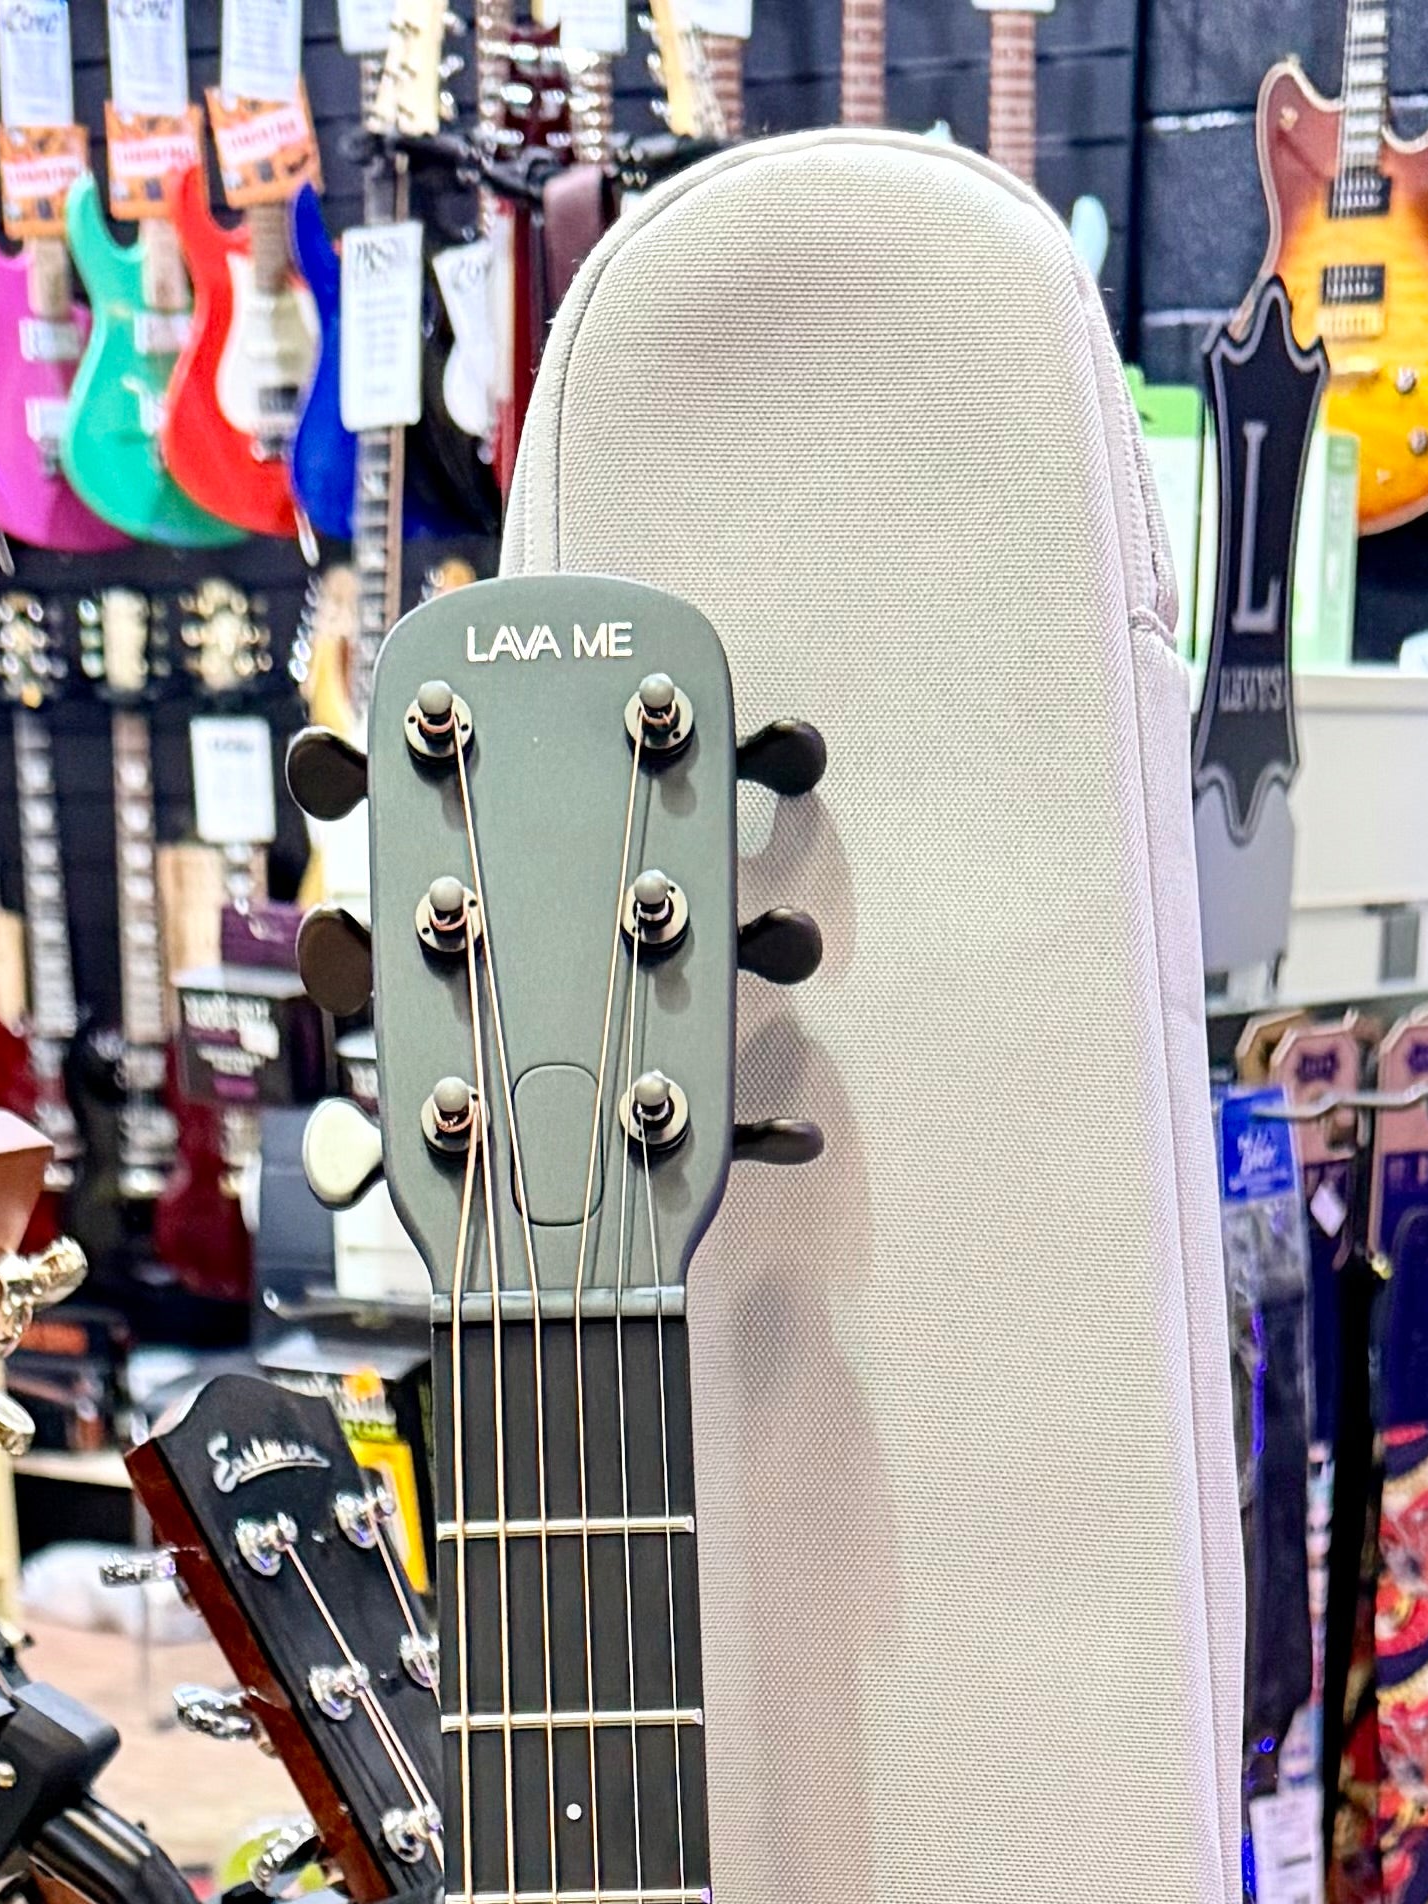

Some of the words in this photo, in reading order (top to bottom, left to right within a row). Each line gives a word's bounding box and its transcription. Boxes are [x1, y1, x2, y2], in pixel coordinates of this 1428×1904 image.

[466, 624, 562, 663] LAVA
[573, 621, 633, 658] ME
[206, 1432, 332, 1494] Eastman
